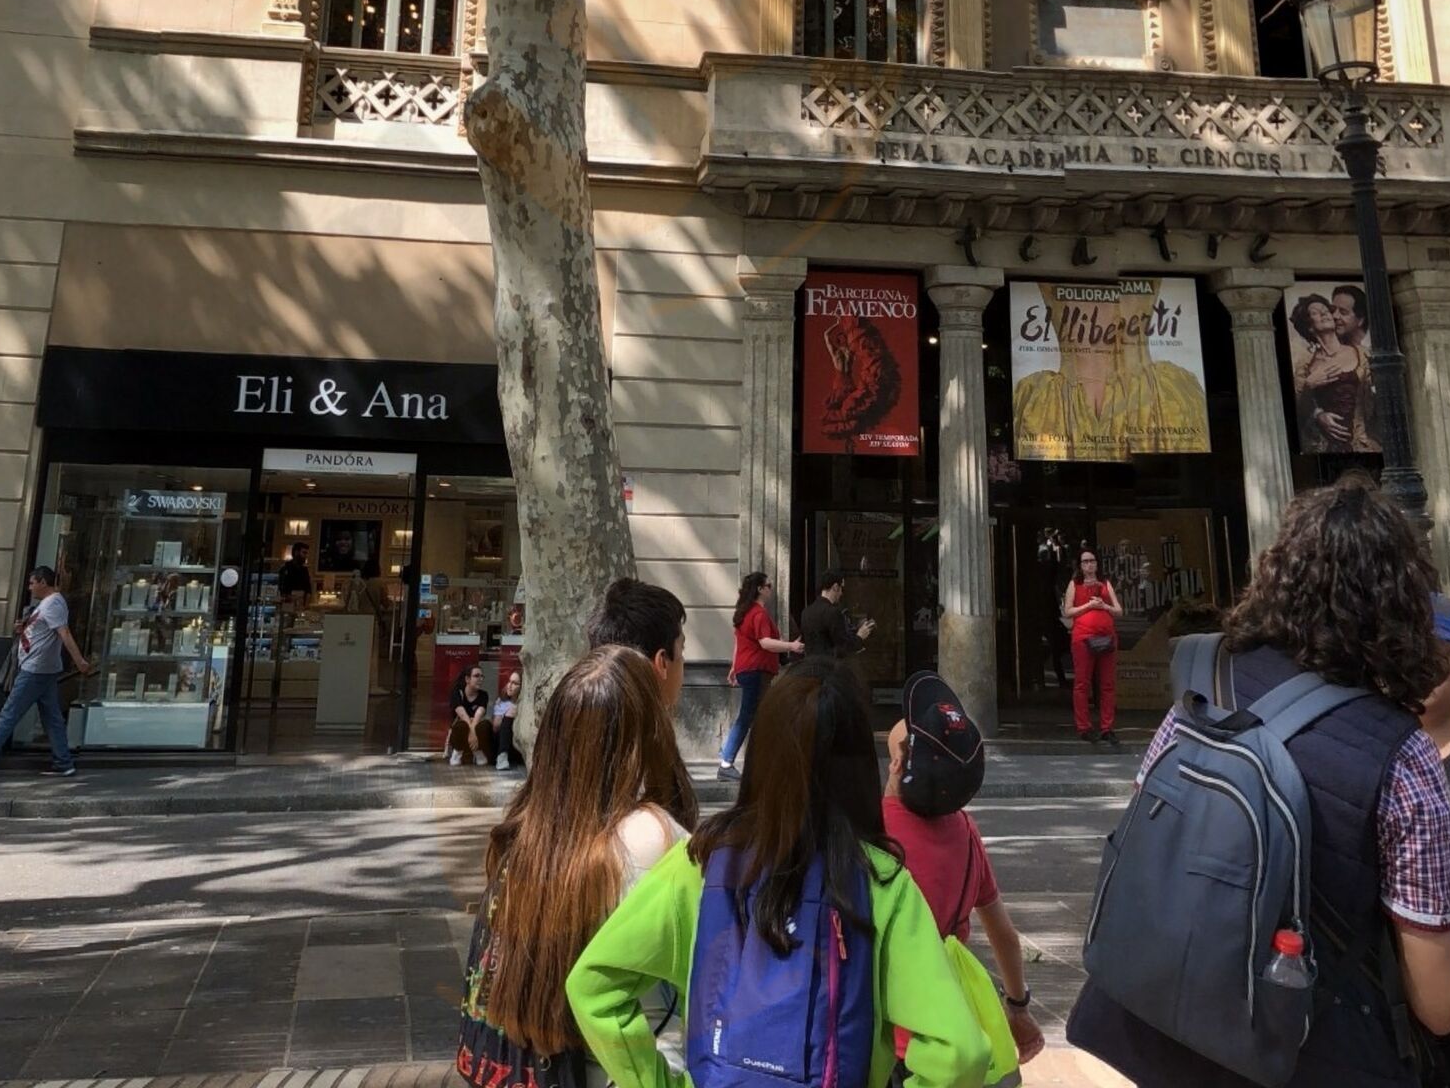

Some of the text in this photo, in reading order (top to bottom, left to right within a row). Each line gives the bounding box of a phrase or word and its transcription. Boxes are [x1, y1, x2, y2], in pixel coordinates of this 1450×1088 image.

[1132, 146, 1158, 164] DE
[826, 284, 902, 301] BARCELONA
[805, 288, 918, 319] FLAMENCO
[234, 375, 449, 420] Eli & Ana
[146, 494, 222, 510] SWAROVSKI
